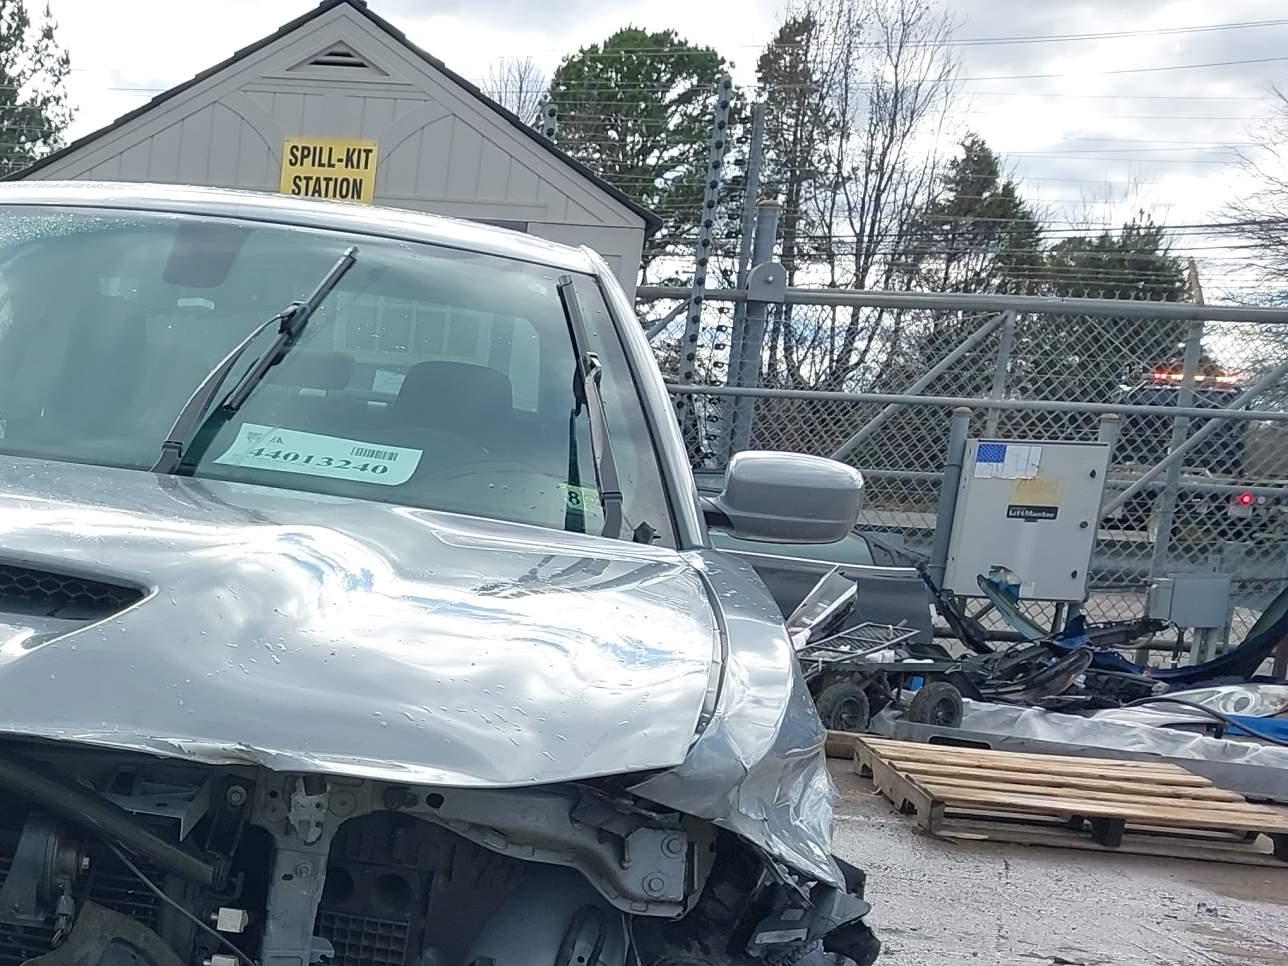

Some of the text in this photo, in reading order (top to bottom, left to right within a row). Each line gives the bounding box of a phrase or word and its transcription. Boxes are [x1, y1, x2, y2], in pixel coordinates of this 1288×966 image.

[289, 145, 374, 170] SPILL-KIT
[292, 175, 364, 200] STATION
[249, 447, 389, 475] 44013240
